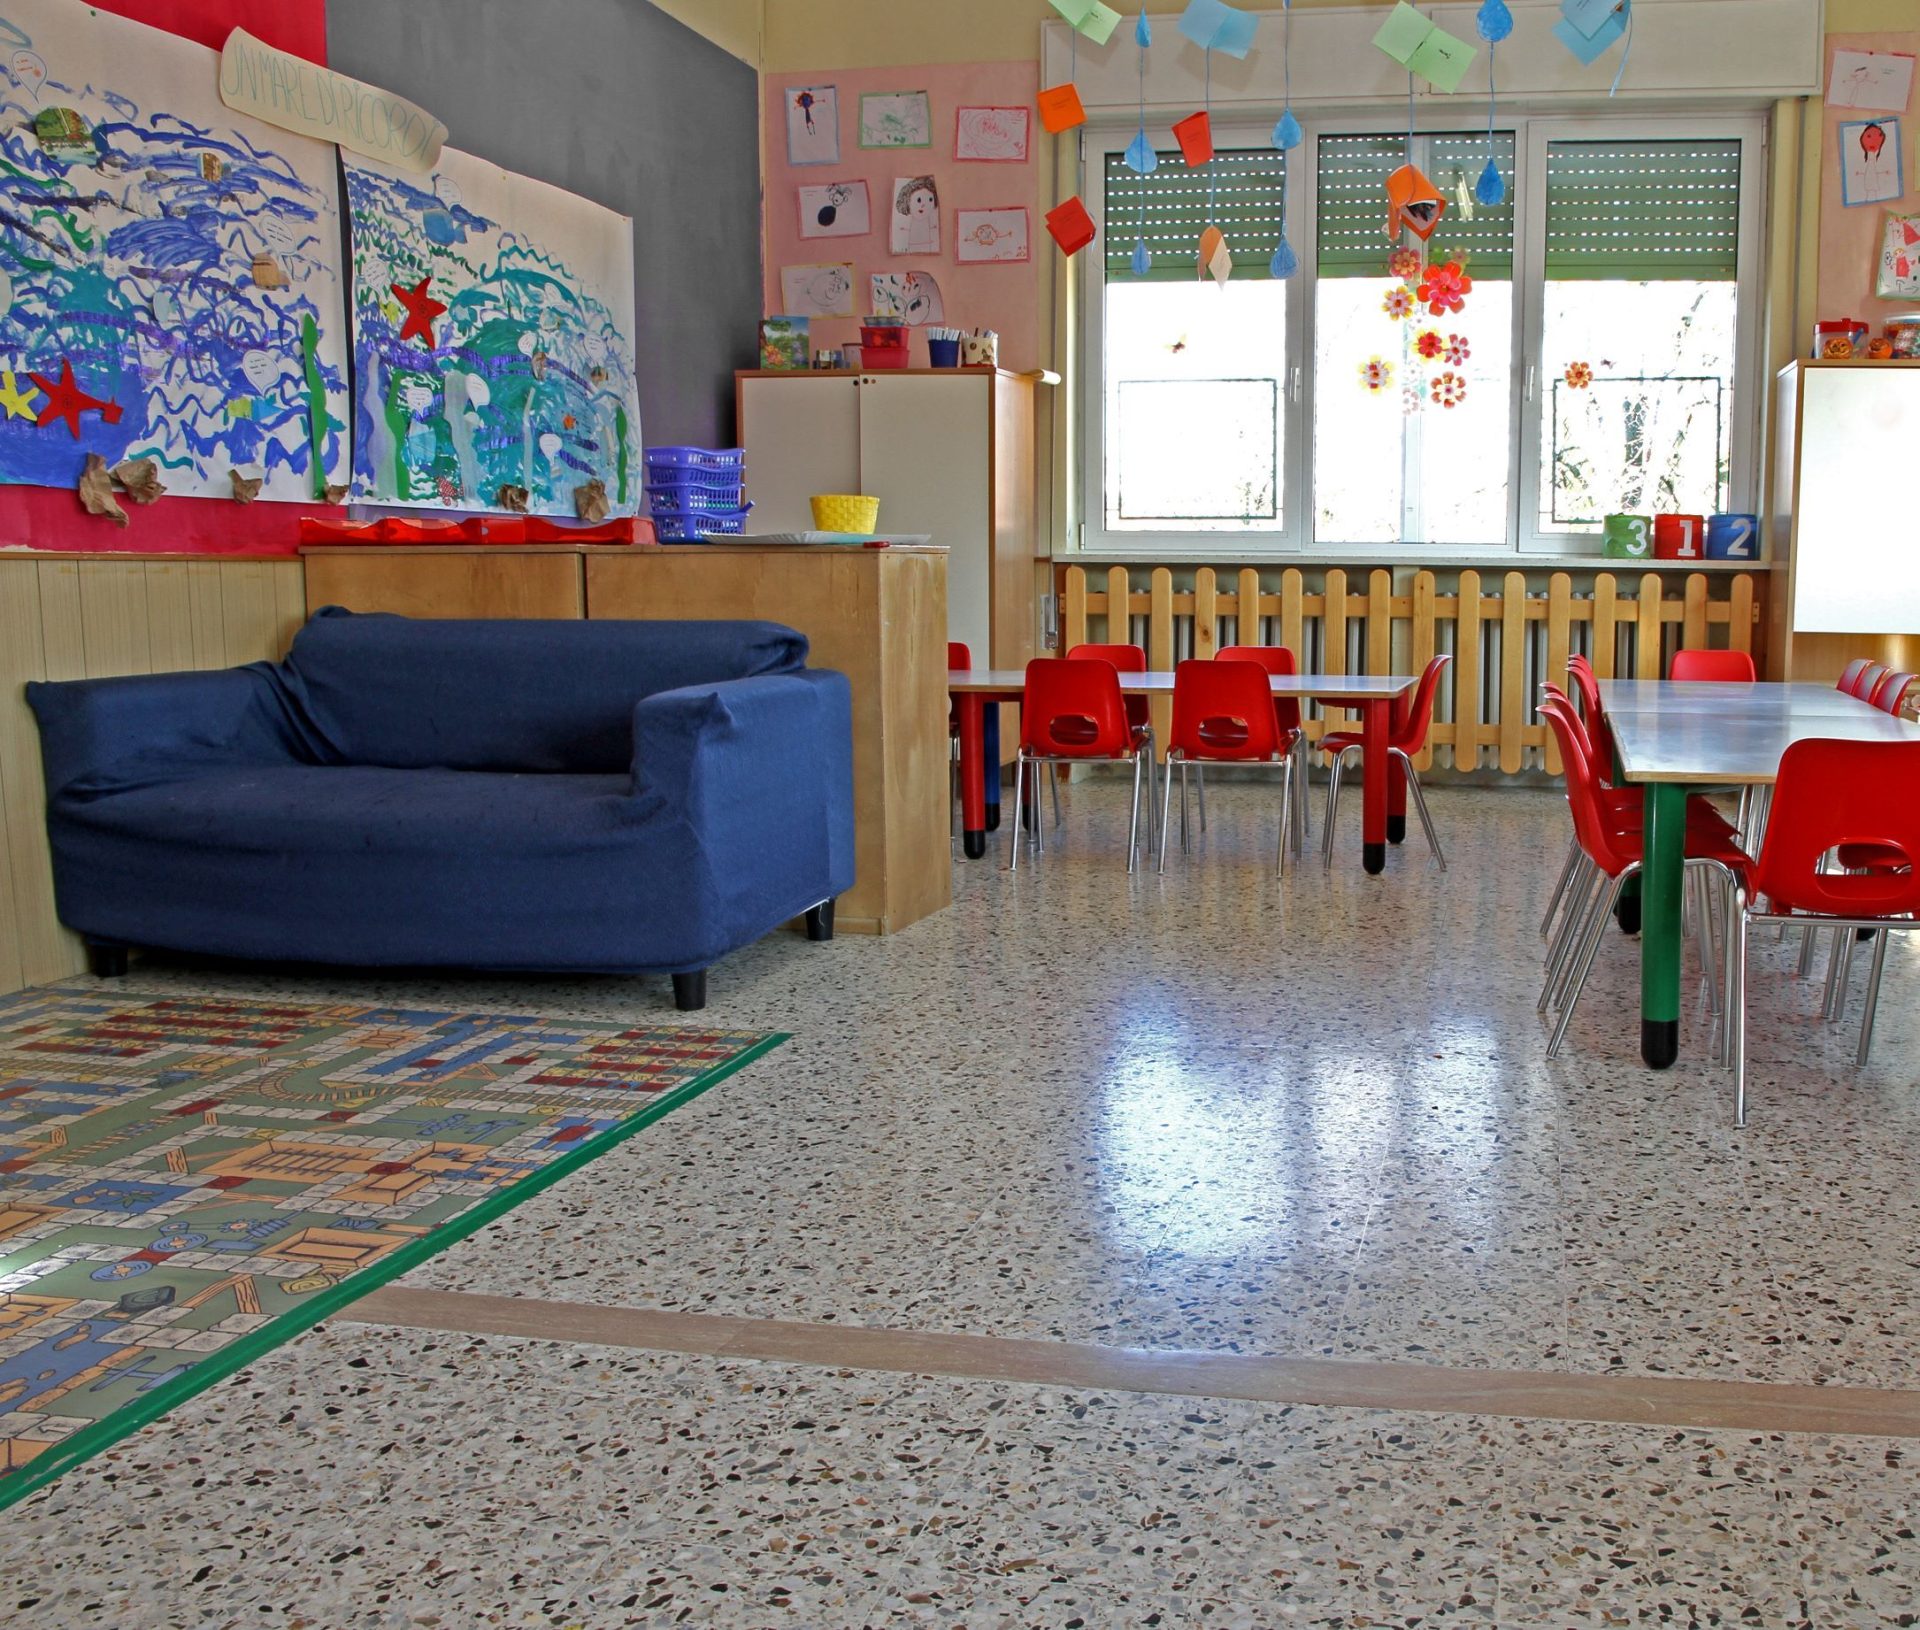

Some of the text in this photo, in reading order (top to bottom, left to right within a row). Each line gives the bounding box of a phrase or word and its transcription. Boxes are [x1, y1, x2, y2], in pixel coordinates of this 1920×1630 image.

[222, 42, 257, 101] UN
[259, 51, 319, 121] MARE
[1626, 519, 1647, 556] 3
[1677, 519, 1696, 557] 1
[1727, 518, 1751, 556] 2
